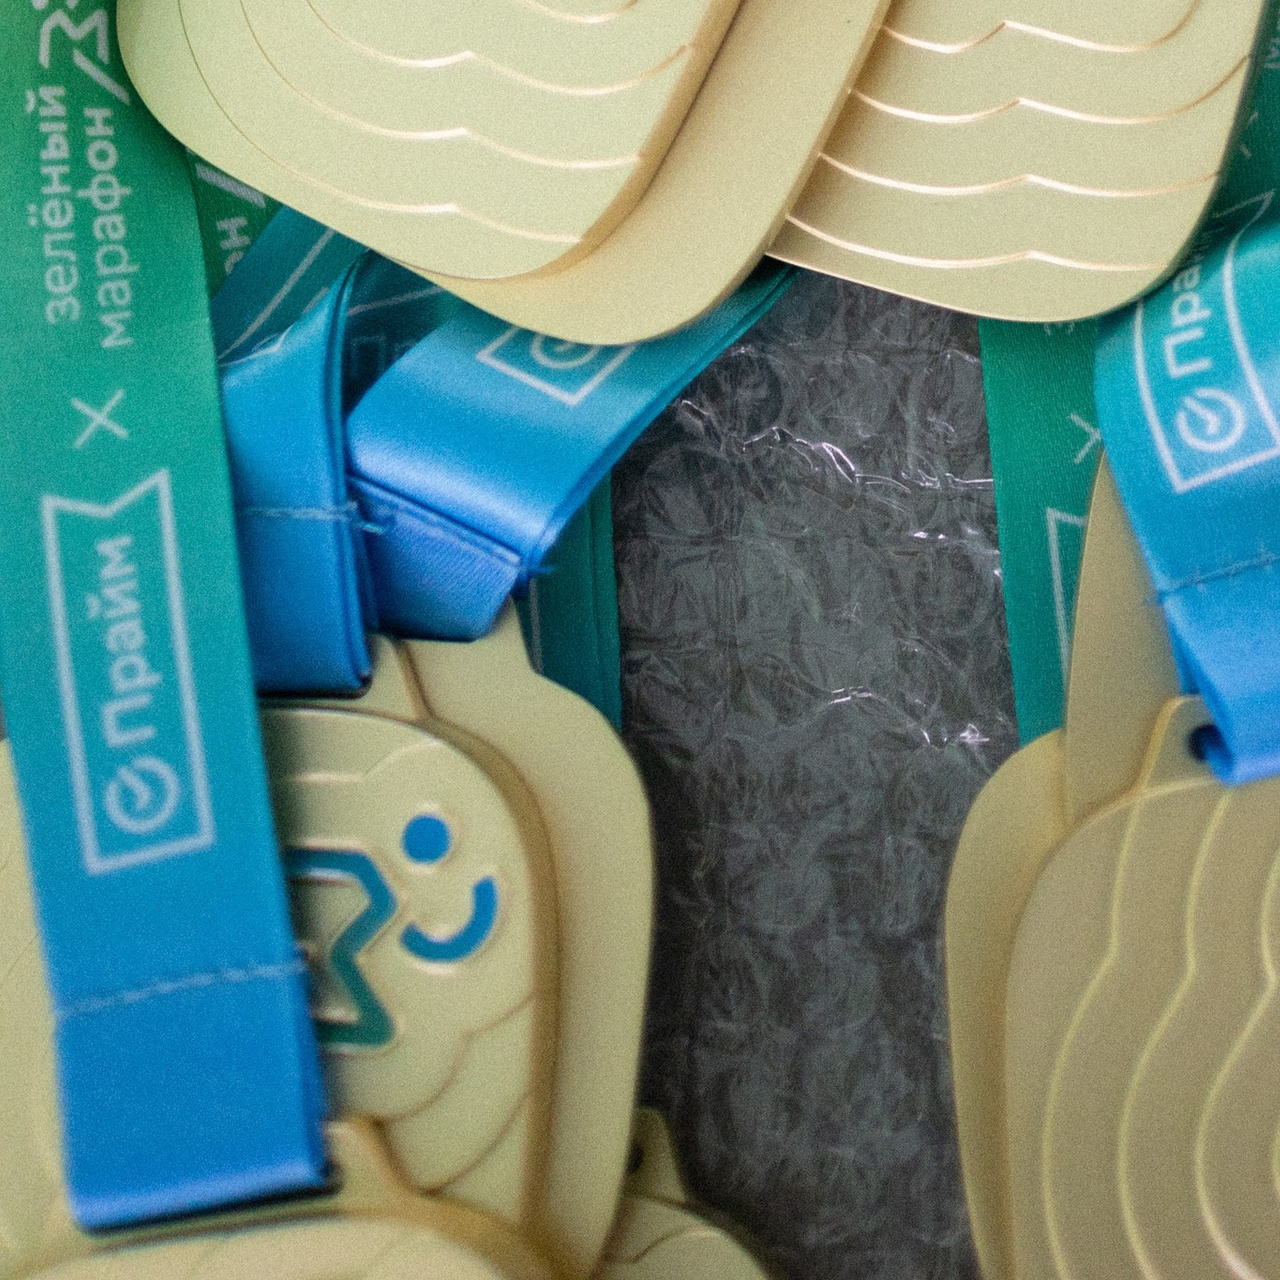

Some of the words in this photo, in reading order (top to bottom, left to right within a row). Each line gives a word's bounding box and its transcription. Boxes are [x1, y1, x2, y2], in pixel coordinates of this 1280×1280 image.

[24, 85, 80, 326] зелёный
[75, 107, 135, 349] марафон
[86, 532, 164, 748] Прайм
